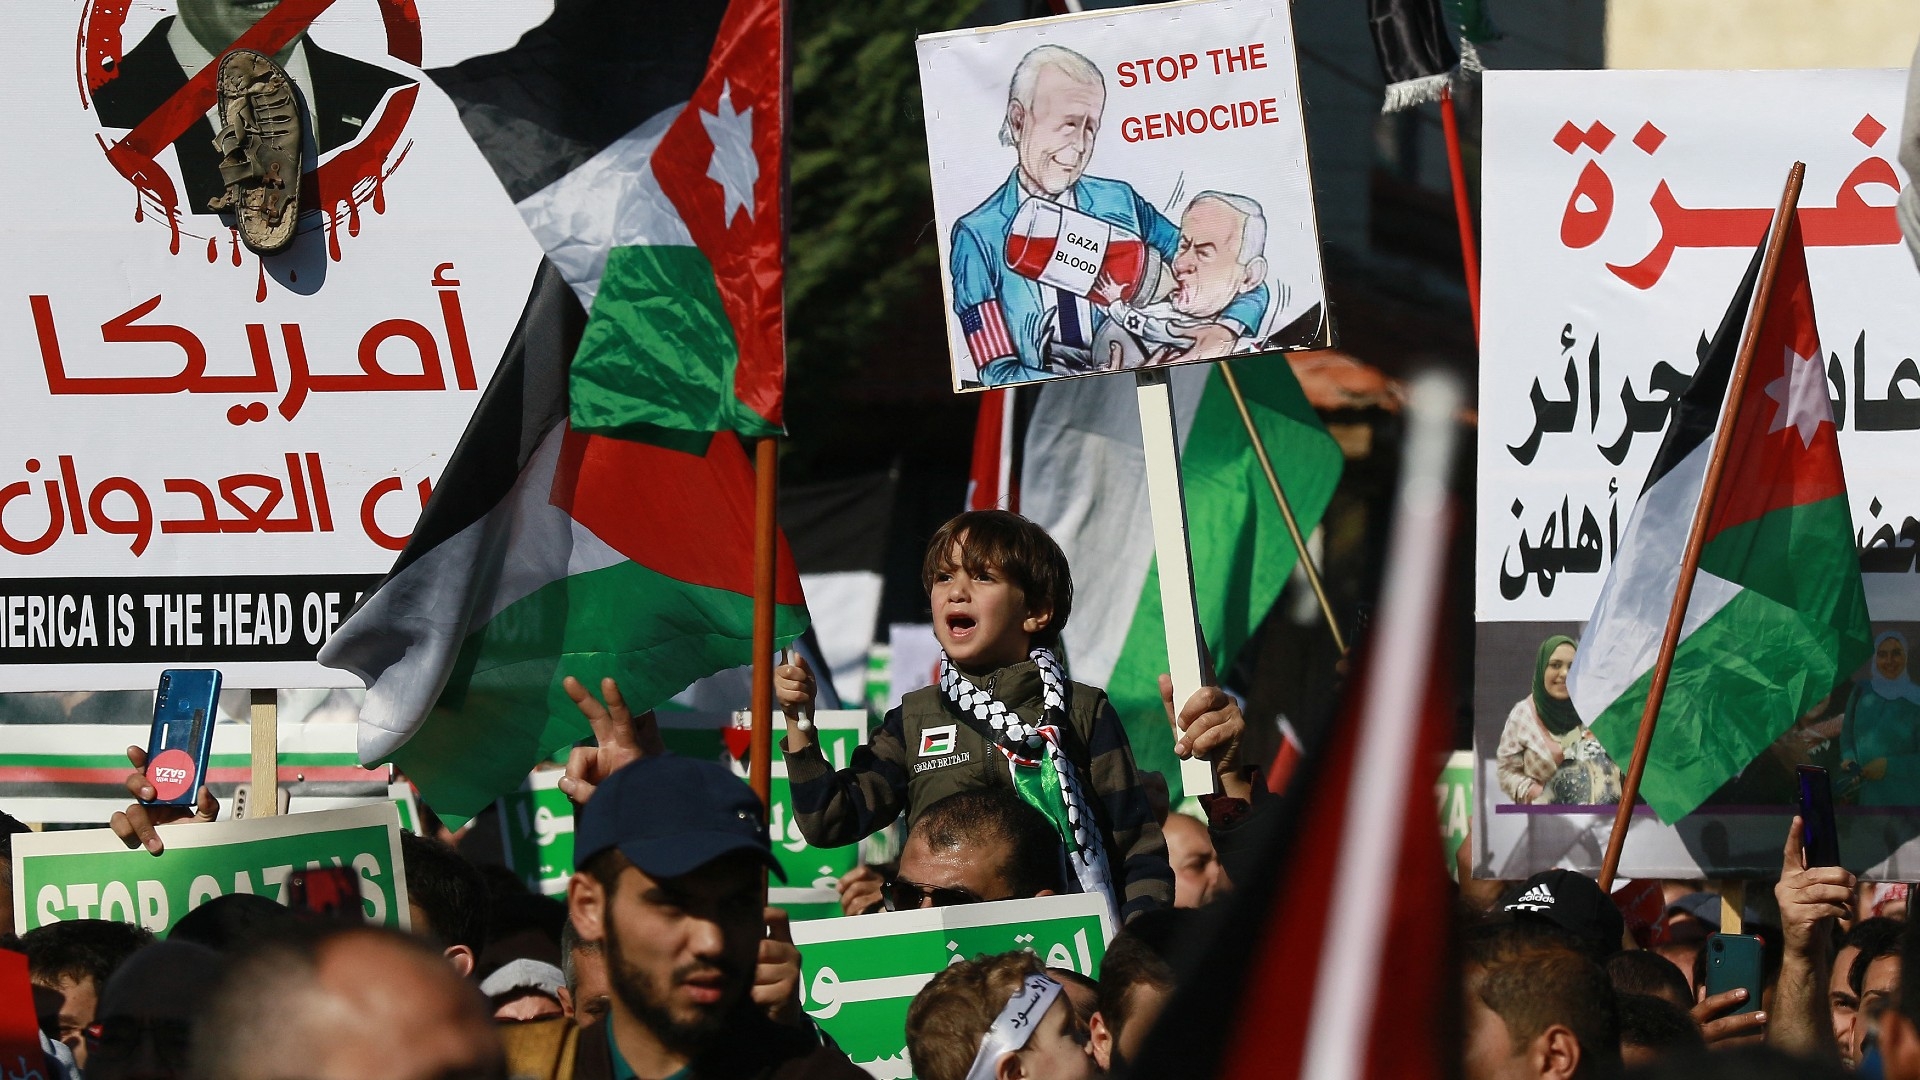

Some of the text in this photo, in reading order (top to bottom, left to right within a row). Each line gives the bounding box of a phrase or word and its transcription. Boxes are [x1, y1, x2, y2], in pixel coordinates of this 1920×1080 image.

[1117, 43, 1268, 88] STOP THE
[1121, 98, 1280, 143] GENOCIDE
[1553, 112, 1904, 290] غزة
[1055, 250, 1096, 274] BLOOD
[1067, 232, 1098, 253] GAZA
[28, 262, 478, 426] أمريكا
[0, 452, 335, 558] العدوان
[0, 591, 341, 649] ERICA IS THE HEAD OF
[155, 766, 187, 779] GAZA
[913, 751, 970, 774] GREAT BRITAIN
[37, 880, 169, 933] STOP
[1517, 892, 1555, 904] adidas
